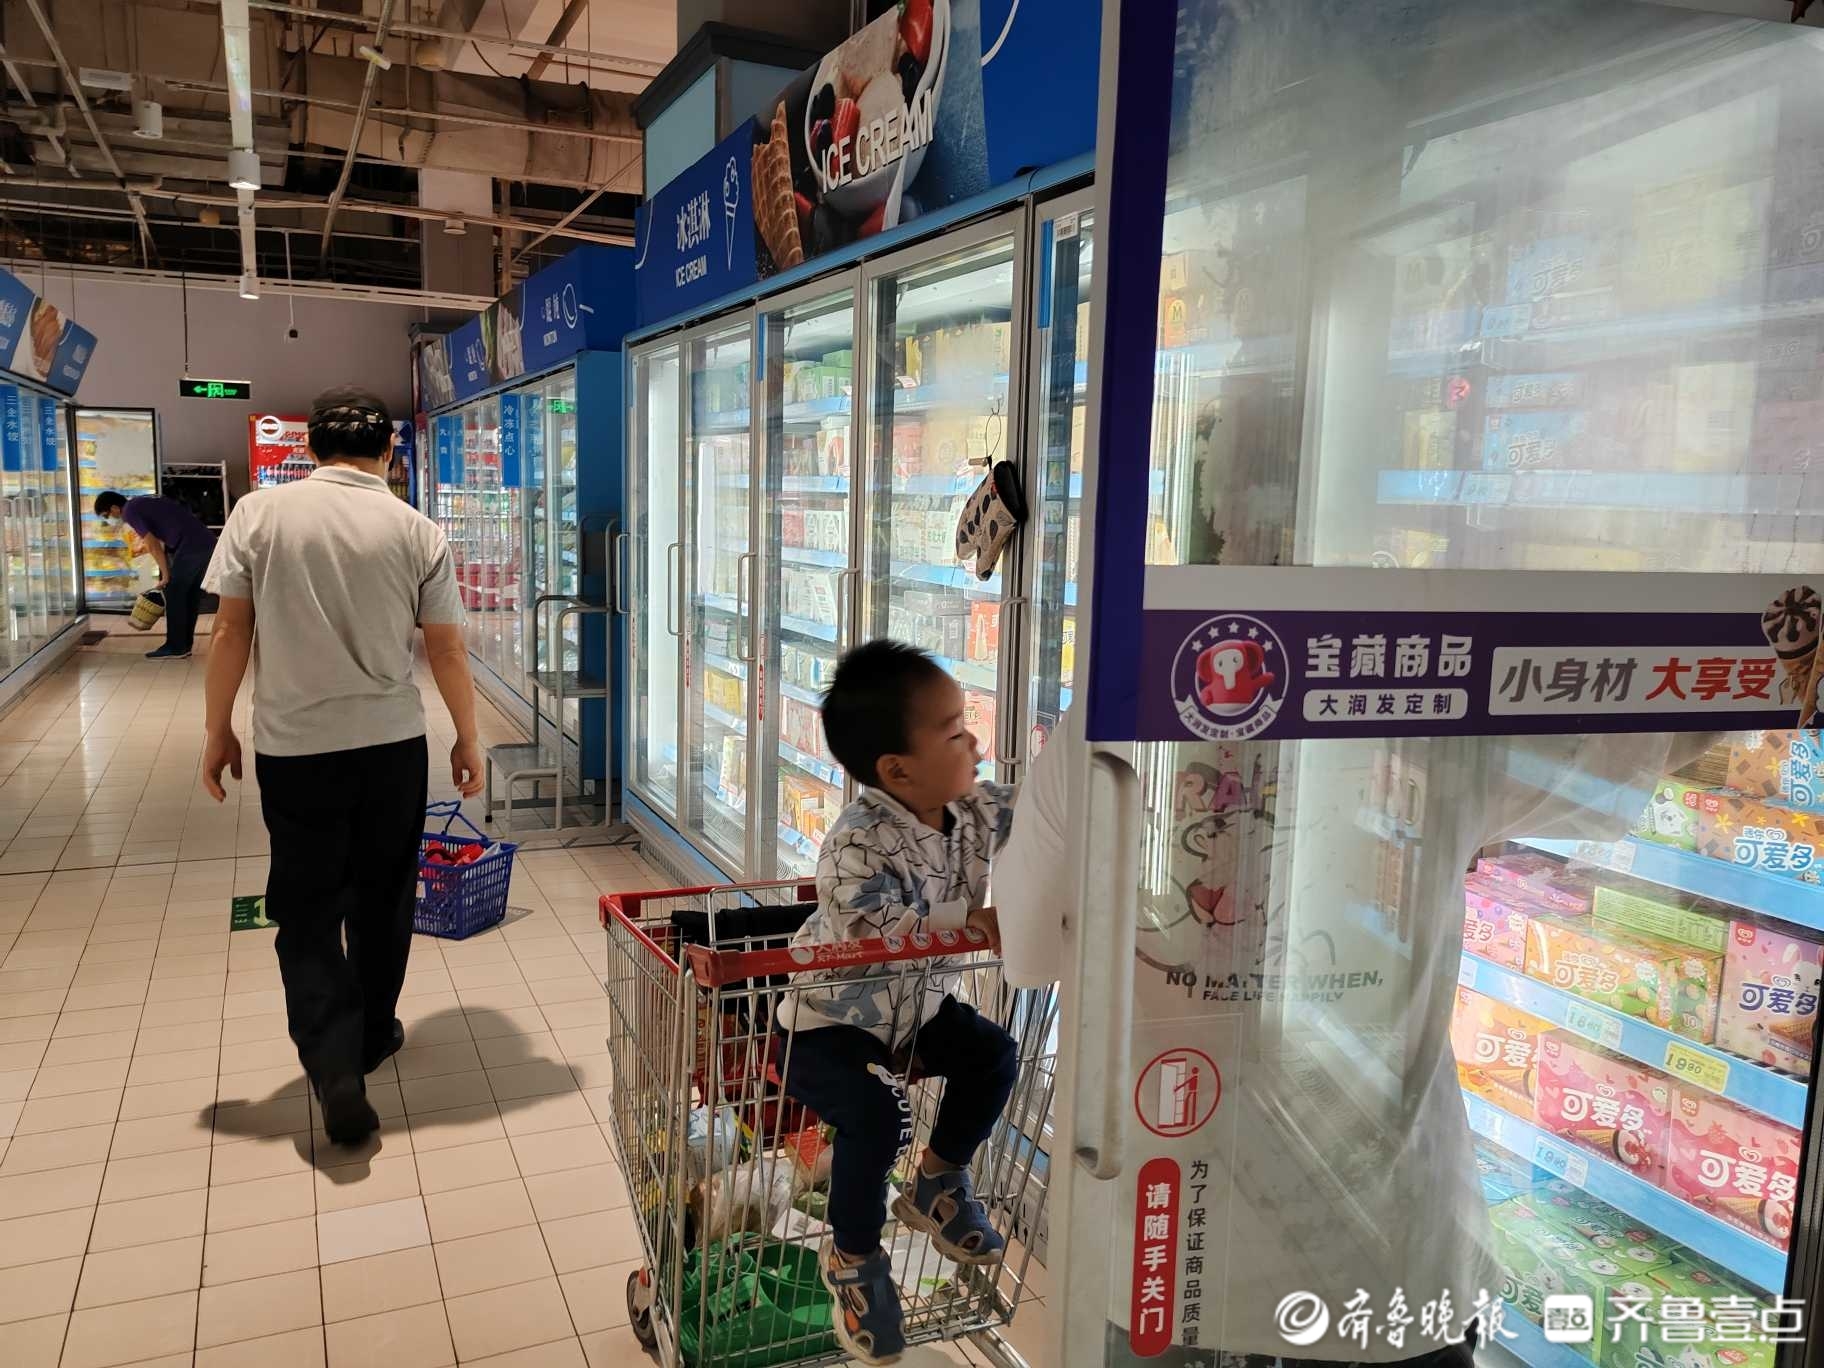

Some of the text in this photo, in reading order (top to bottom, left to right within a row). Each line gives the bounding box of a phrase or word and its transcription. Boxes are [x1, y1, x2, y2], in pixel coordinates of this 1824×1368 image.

[822, 88, 933, 194] ICE CREAM
[676, 190, 711, 252] 冰淇淋
[676, 254, 708, 288] ICE CREAM
[504, 405, 516, 456] 冷冻点心
[1304, 634, 1473, 678] 宝藏商品
[1499, 656, 1777, 703] 小身材 大享受
[1319, 694, 1453, 716] 大润发定制
[1734, 838, 1813, 870] 可爱多
[1166, 972, 1197, 986] NO
[1555, 962, 1618, 992] 可爱多
[1739, 983, 1817, 1015] 可爱多
[1475, 1033, 1541, 1067] 可爱
[1562, 1087, 1645, 1131] 可爱多
[1699, 1149, 1797, 1202] 可爱多
[1140, 1182, 1172, 1336] 请随手关门
[1182, 1159, 1209, 1347] 为了保证商品质量
